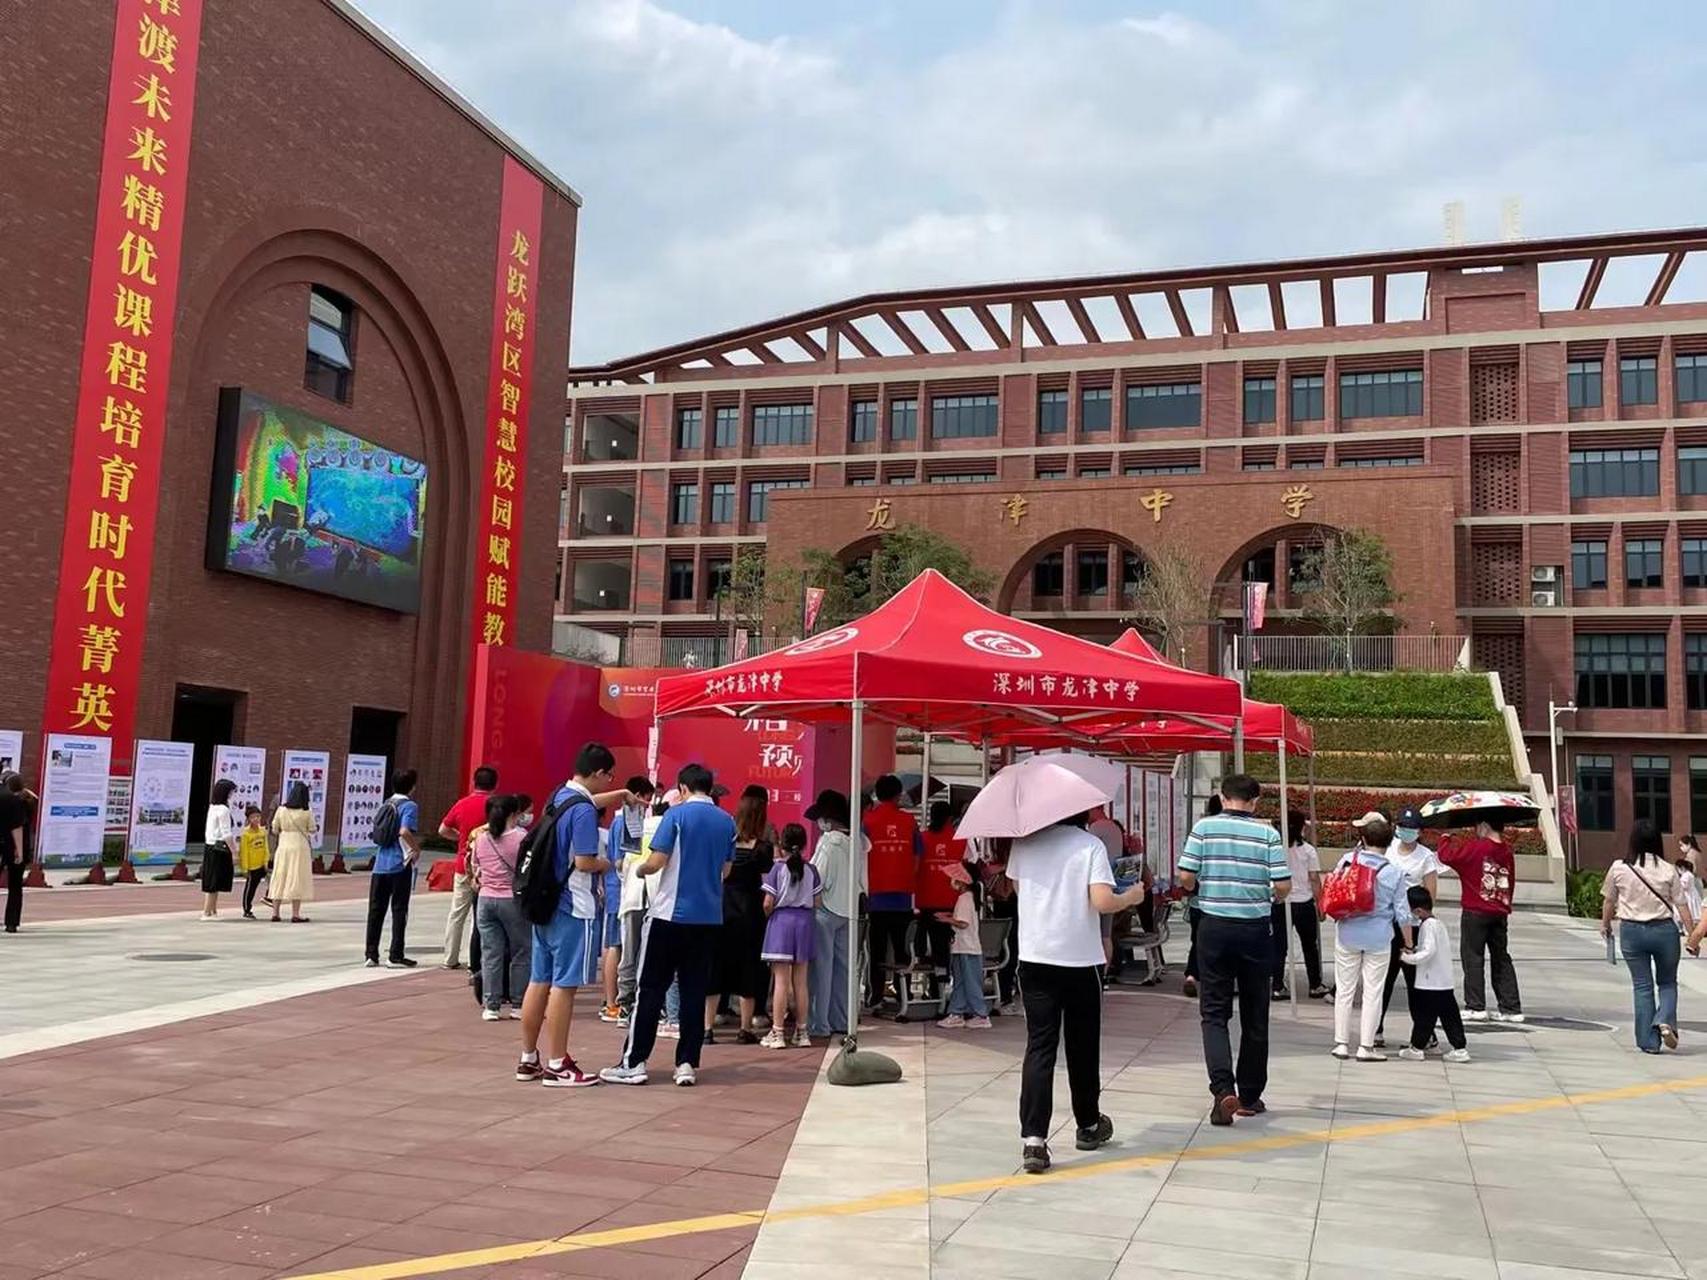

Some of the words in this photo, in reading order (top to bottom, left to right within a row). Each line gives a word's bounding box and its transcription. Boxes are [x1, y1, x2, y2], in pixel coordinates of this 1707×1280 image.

[483, 229, 531, 646] 龙跃湾区智慧校园赋能教
[866, 484, 1315, 532] 龙津中学
[992, 673, 1141, 703] 深圳市龙津中学
